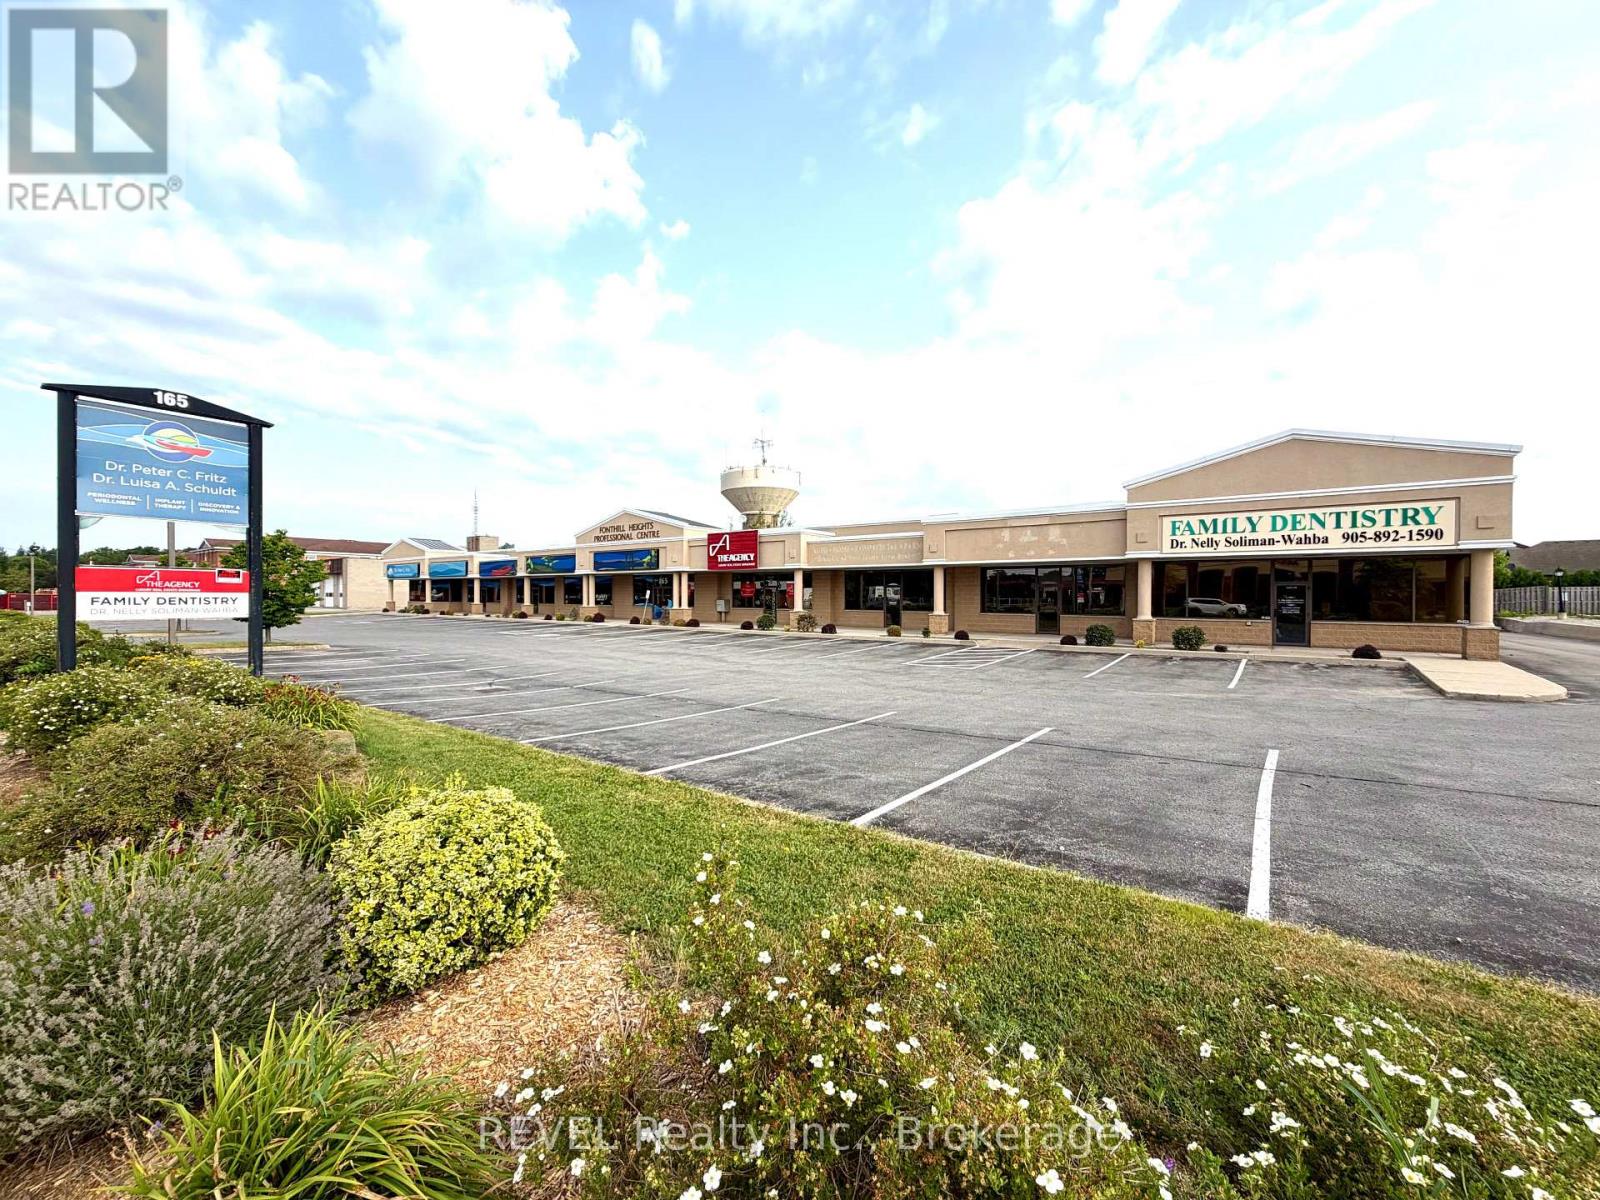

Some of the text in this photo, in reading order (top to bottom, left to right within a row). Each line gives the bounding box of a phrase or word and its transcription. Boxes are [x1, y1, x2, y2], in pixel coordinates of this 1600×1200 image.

[153, 391, 189, 408] 165
[105, 460, 228, 484] Dr. Peter C. Fritz
[92, 473, 237, 497] Dr. Luisa A. Schuldt
[599, 522, 654, 534] FONTHILL HEIGHTS
[1169, 505, 1445, 537] FAMILY DENTISTRY
[593, 530, 660, 542] PROFESSIONAL CENTRE
[1170, 527, 1444, 551] Dr. Nelly Soliman-Wahba 905-892-1590
[90, 596, 239, 606] FAMILY DENTISTRY
